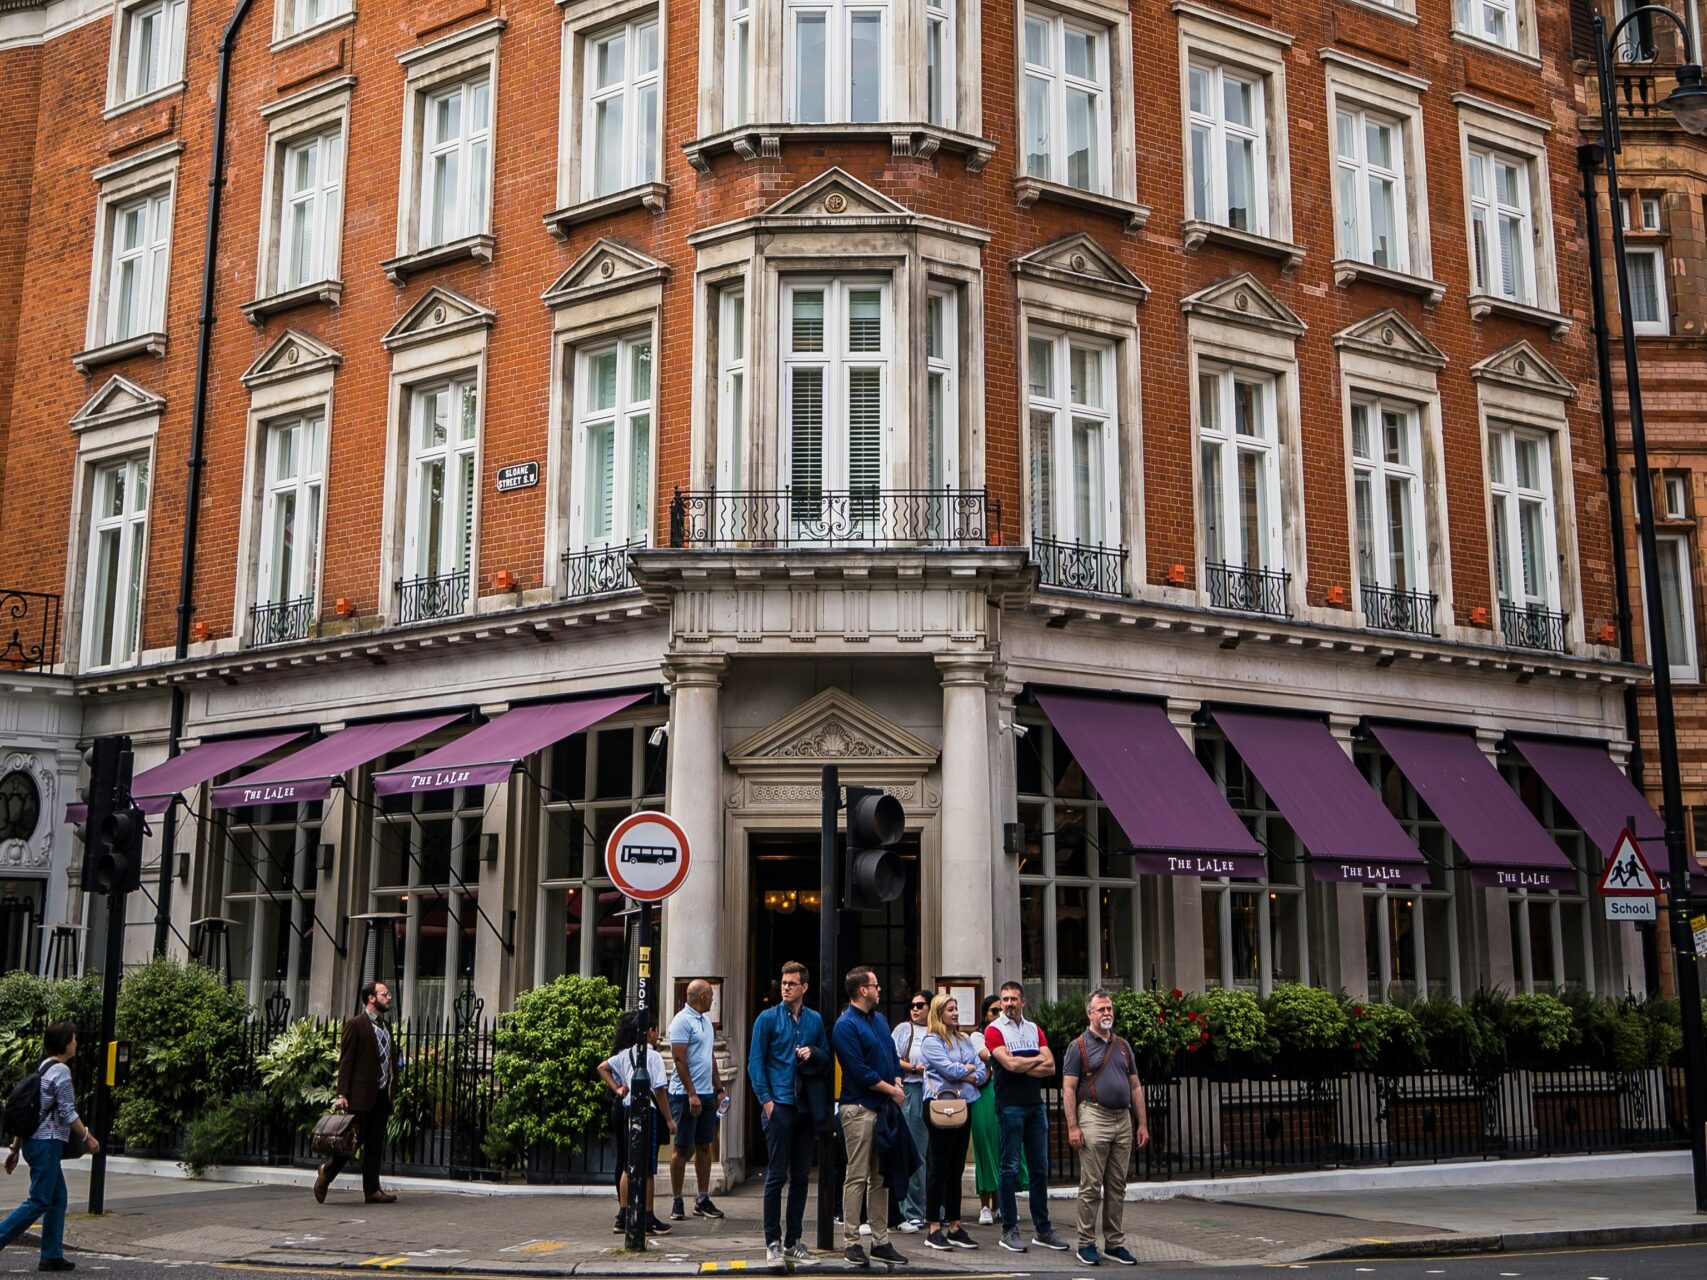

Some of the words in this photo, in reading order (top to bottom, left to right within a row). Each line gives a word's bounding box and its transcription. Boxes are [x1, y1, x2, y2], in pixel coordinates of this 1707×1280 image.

[505, 465, 529, 478] SLOANE
[498, 476, 522, 488] STREET
[412, 775, 432, 788] THE
[244, 790, 262, 802] THE
[1168, 857, 1192, 870] THE
[1197, 858, 1235, 872] LALEE
[1341, 865, 1363, 878] THE
[1367, 866, 1401, 879] LALEE
[1497, 871, 1517, 884] THE
[1520, 872, 1550, 885] LALEE
[1611, 902, 1650, 914] School
